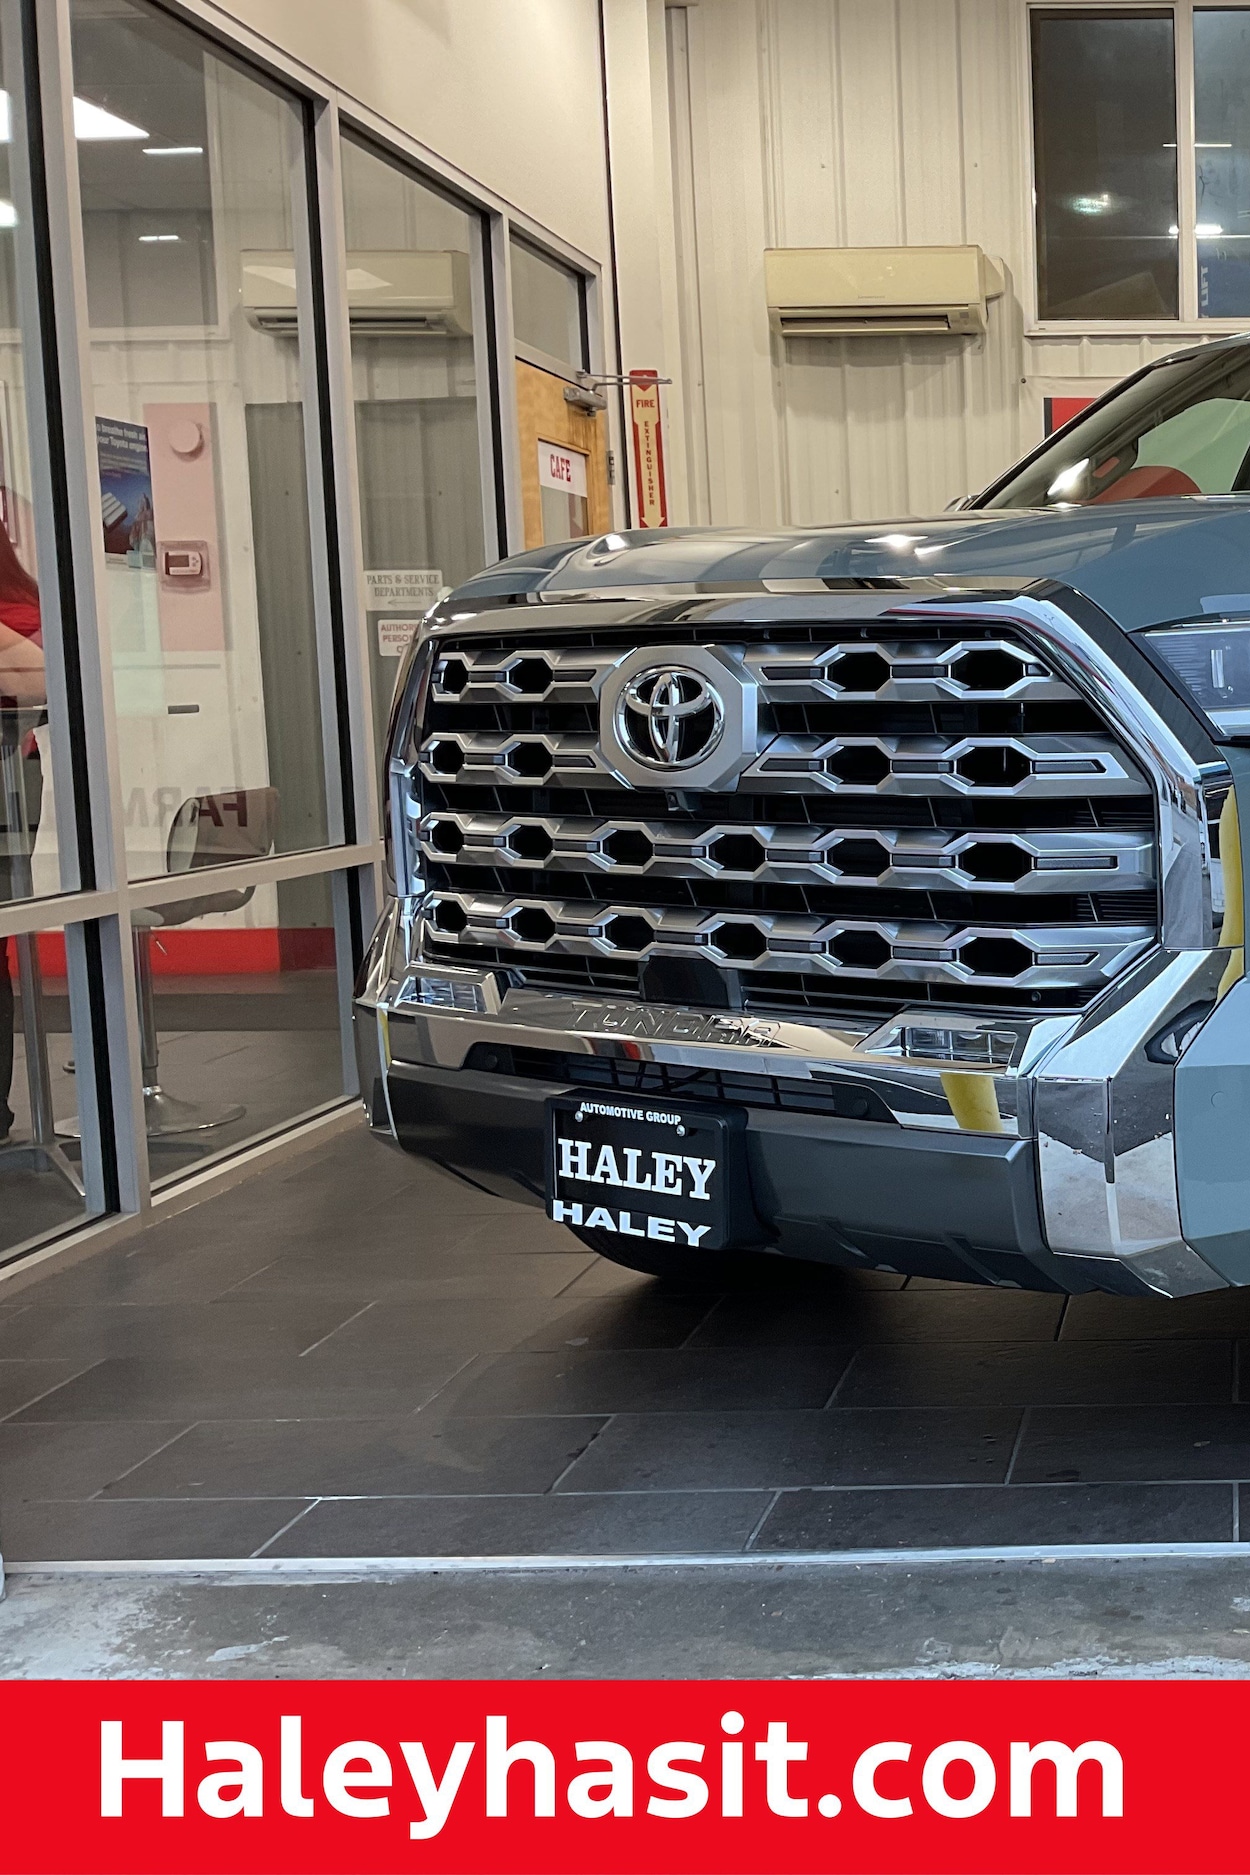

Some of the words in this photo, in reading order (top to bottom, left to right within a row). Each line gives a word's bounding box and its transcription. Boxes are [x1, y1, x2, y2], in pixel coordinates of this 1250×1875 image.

[636, 399, 655, 409] FIRE
[109, 436, 129, 449] Toyota
[550, 453, 572, 483] CAFE
[644, 420, 656, 506] EXTINGUISHER
[367, 574, 393, 585] PARTS
[394, 575, 402, 584] &
[403, 574, 440, 585] SERVICE
[374, 587, 434, 597] DEPARTMENTS
[566, 1000, 781, 1048] TUNDRA
[580, 1102, 645, 1121] AUTOMOTIVE
[646, 1110, 682, 1126] GROUP
[557, 1138, 716, 1200] HALEY
[552, 1199, 712, 1248] HALEY
